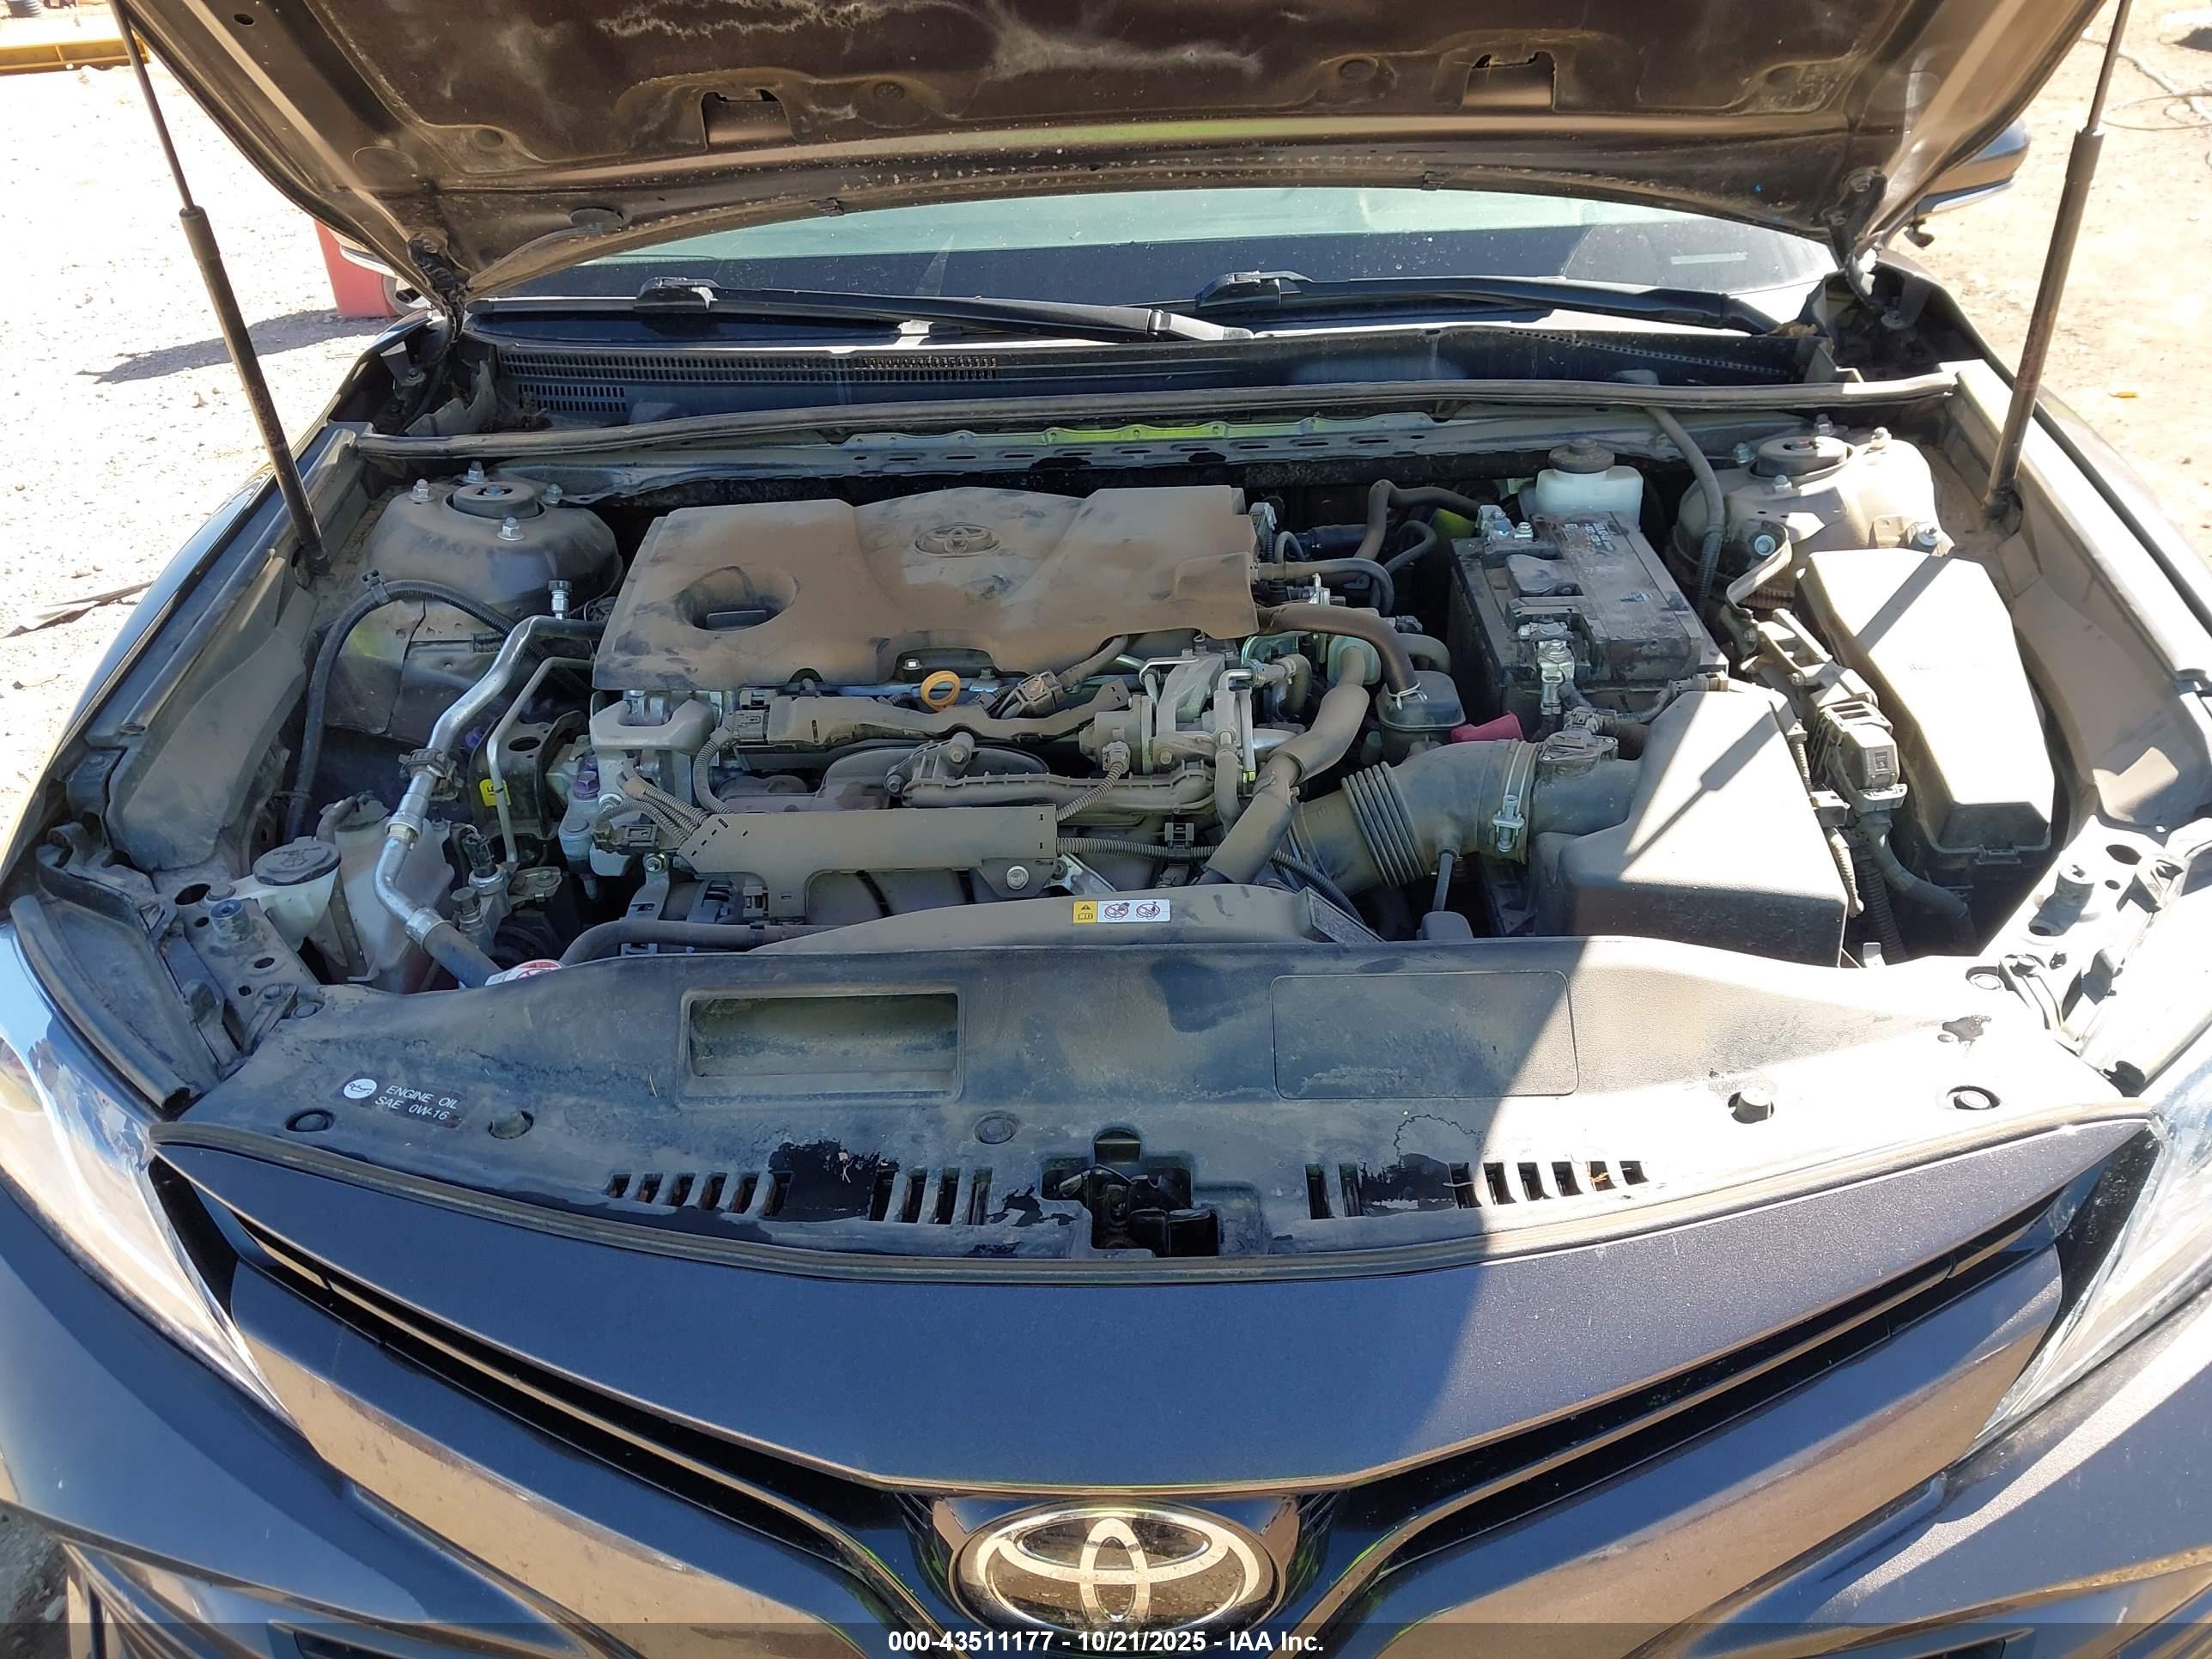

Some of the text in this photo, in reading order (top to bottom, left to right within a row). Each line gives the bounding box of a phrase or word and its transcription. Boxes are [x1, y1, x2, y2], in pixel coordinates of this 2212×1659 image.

[374, 1096, 450, 1121] SAE 0W-16
[386, 1085, 460, 1109] ENGINE OIL
